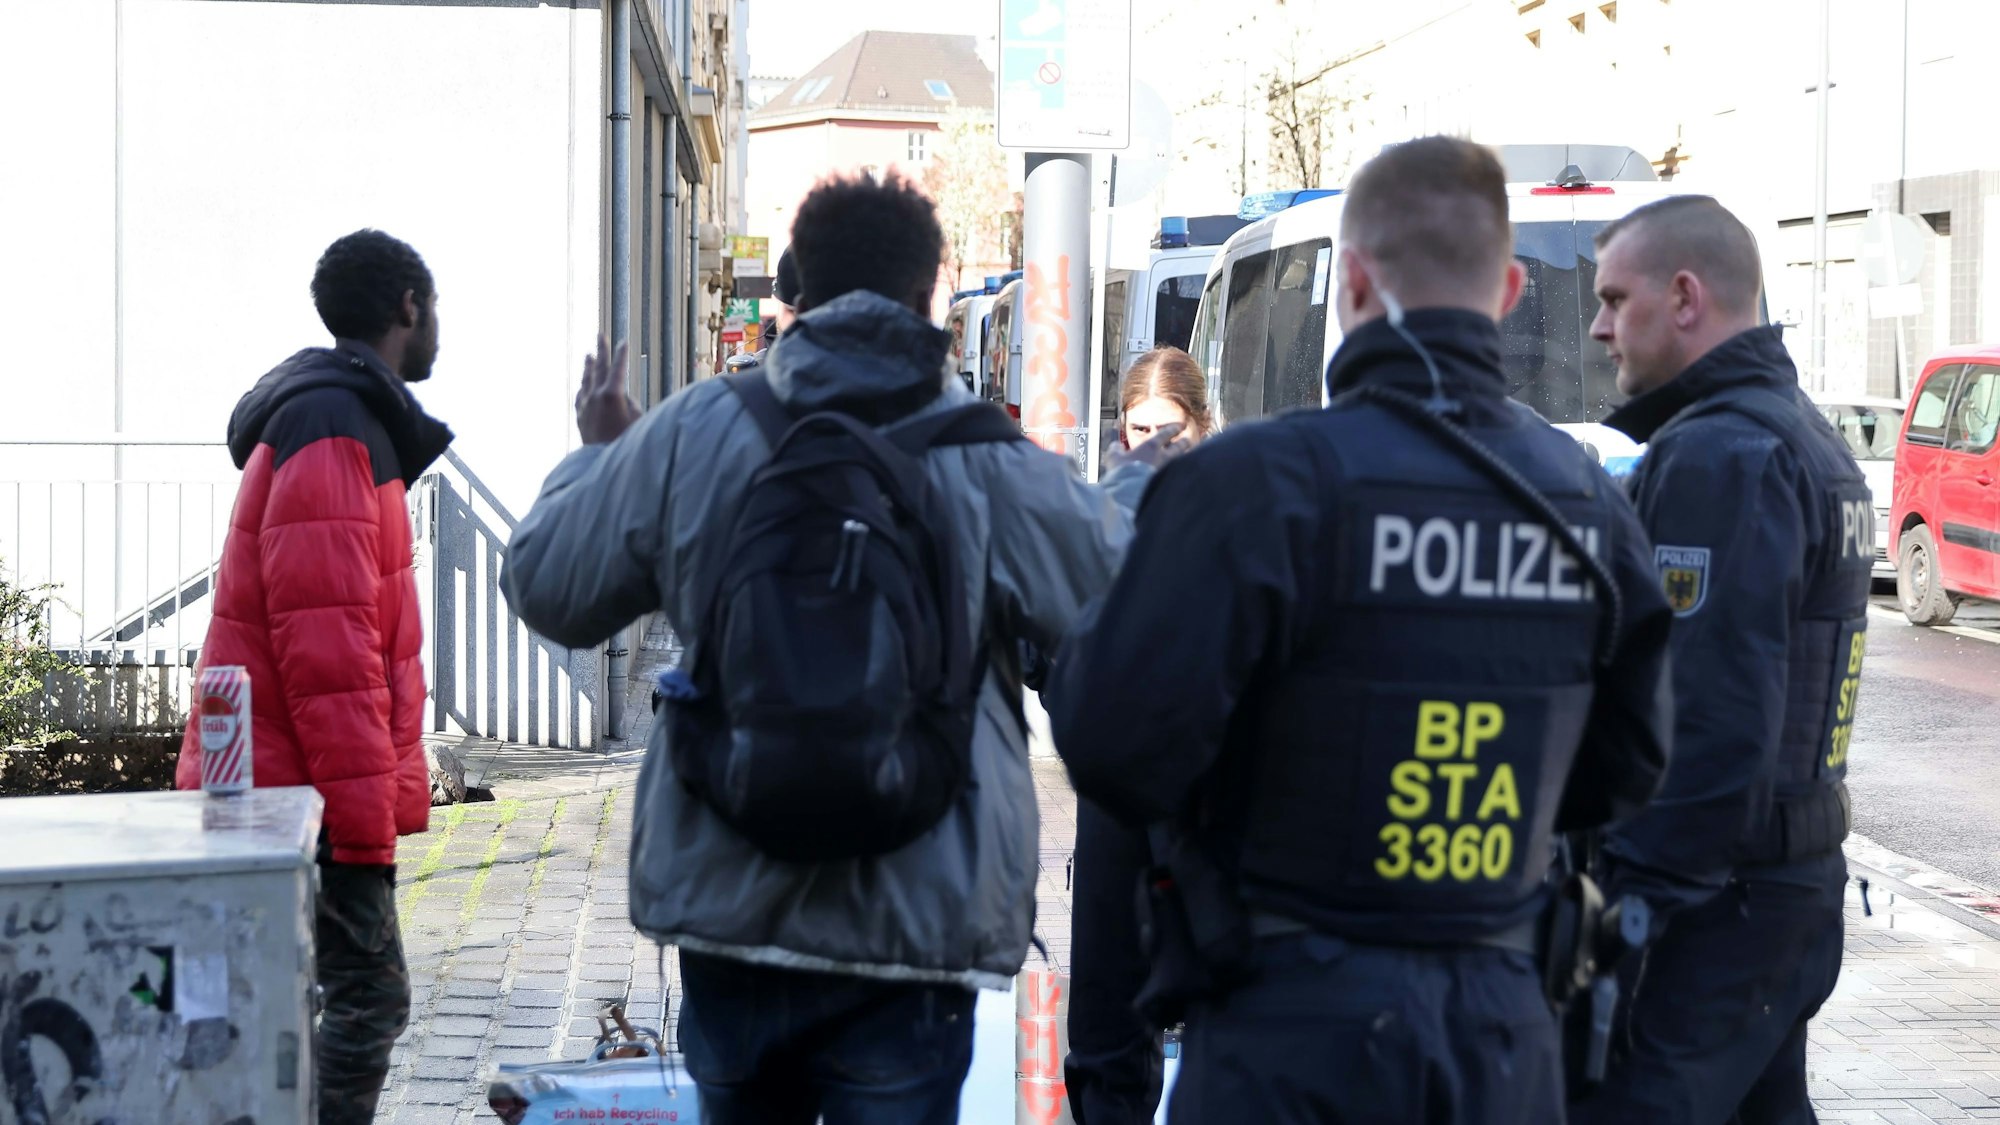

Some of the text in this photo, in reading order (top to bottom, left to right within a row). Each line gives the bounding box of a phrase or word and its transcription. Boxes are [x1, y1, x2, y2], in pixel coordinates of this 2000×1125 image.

[1370, 514, 1599, 601] POLIZEI
[1660, 550, 1704, 566] POLIZEI
[1414, 700, 1505, 760] BP
[1387, 760, 1522, 821] STA
[1374, 823, 1513, 882] 3360
[553, 1107, 678, 1122] Ich hab Recycling
